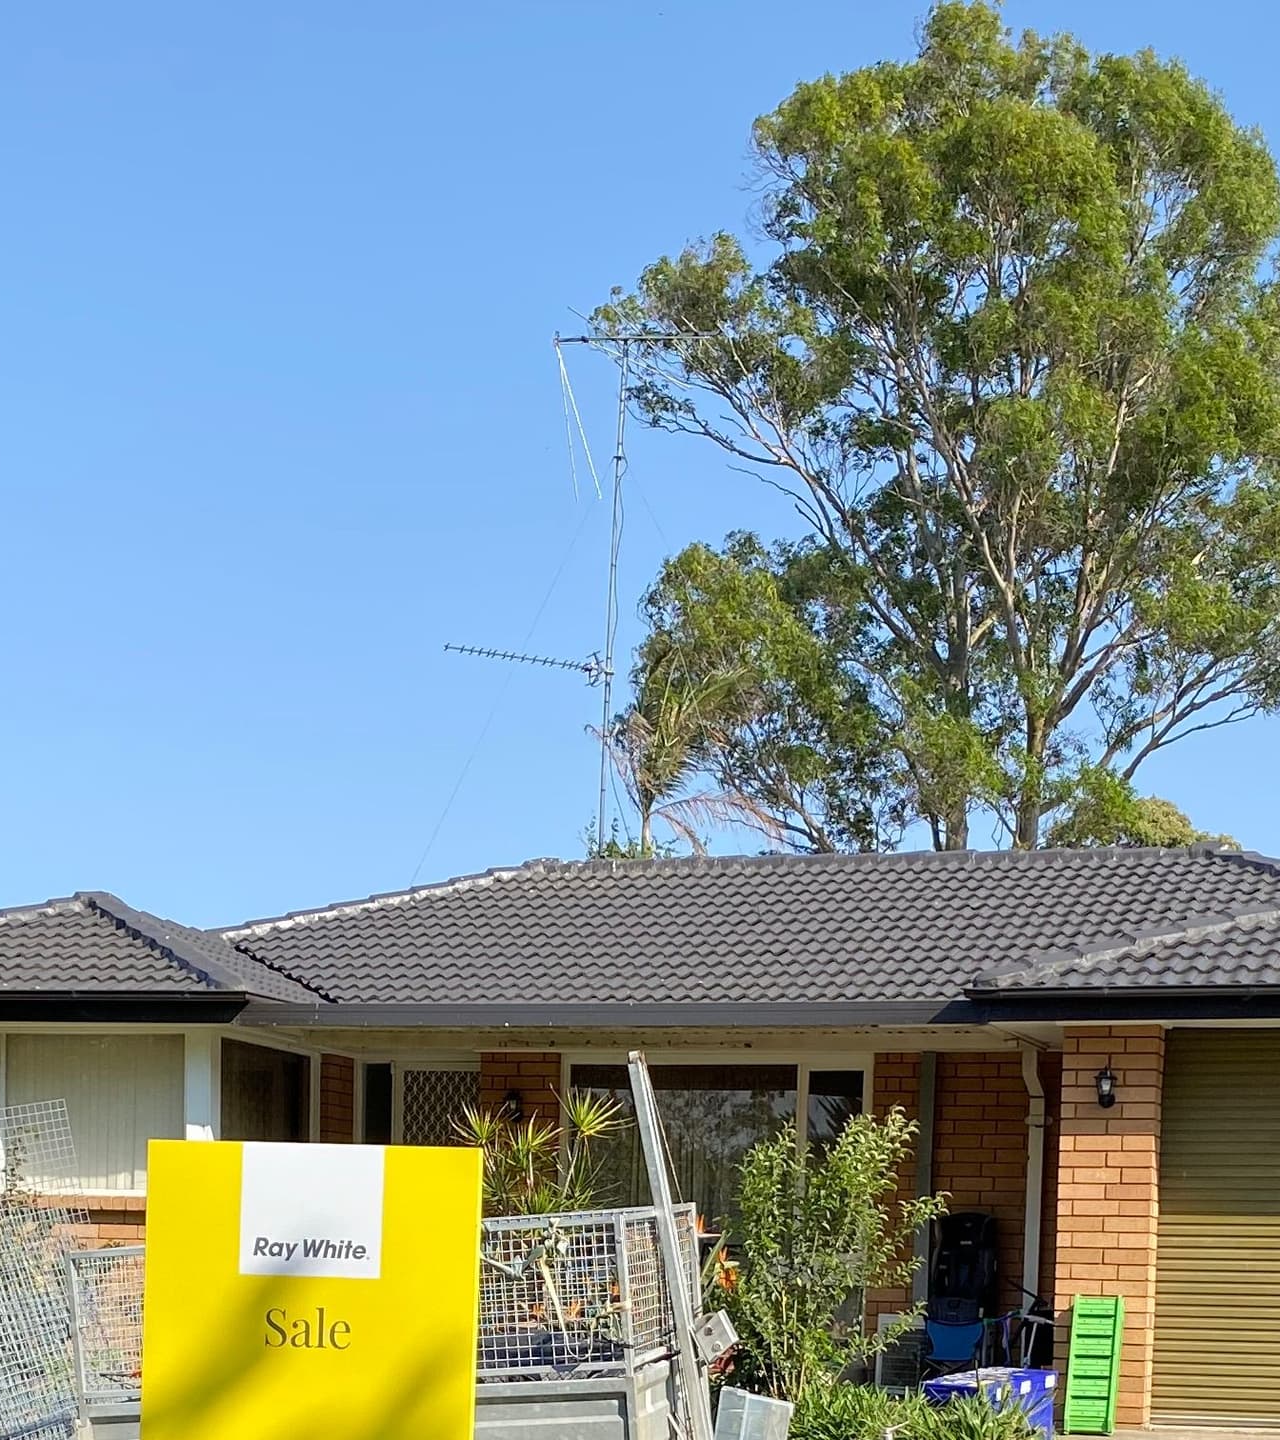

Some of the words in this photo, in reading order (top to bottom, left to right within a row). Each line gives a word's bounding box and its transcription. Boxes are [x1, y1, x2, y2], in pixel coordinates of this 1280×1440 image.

[253, 1237, 298, 1261] Ray
[303, 1239, 367, 1260] White
[264, 1307, 351, 1349] Sale
